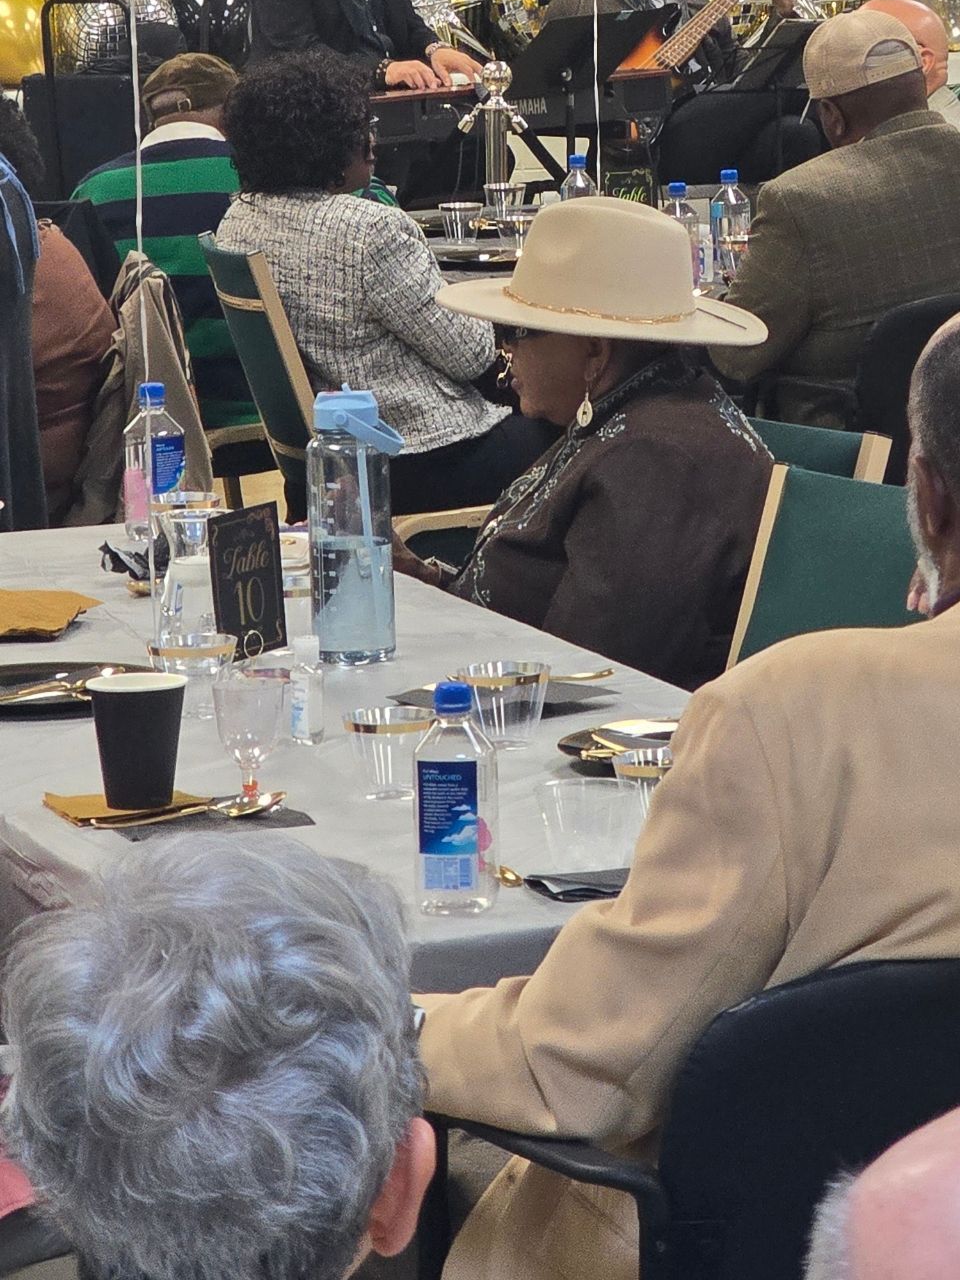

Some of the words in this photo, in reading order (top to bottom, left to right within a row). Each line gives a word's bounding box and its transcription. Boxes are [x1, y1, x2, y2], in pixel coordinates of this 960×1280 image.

[612, 186, 648, 202] Table
[223, 540, 270, 580] Table
[233, 576, 265, 626] 10
